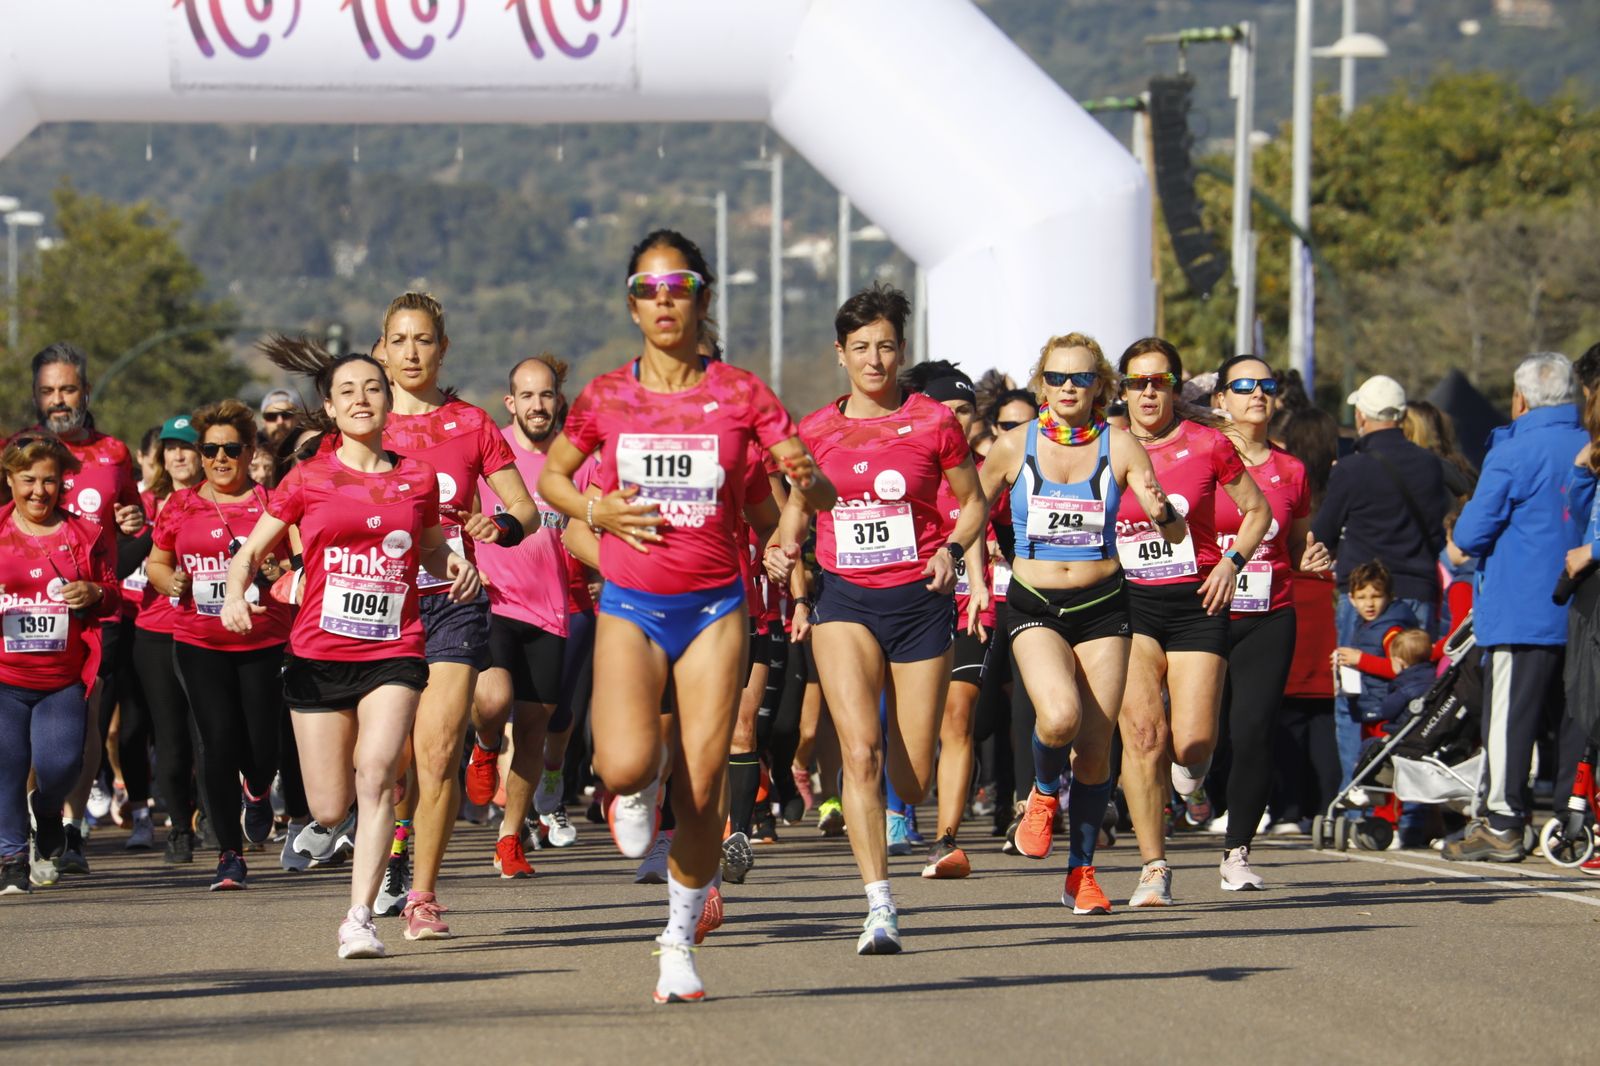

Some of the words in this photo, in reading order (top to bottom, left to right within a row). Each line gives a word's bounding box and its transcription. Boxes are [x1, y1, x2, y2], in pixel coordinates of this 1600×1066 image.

[643, 454, 692, 478] 1119
[1048, 512, 1083, 530] 243
[853, 521, 889, 545] 375
[182, 551, 231, 574] Pink
[324, 546, 387, 576] Pink
[1138, 541, 1174, 561] 494
[210, 582, 227, 599] 70
[342, 592, 389, 617] 1094
[18, 616, 56, 634] 1397
[1421, 695, 1457, 738] MACLAREN
